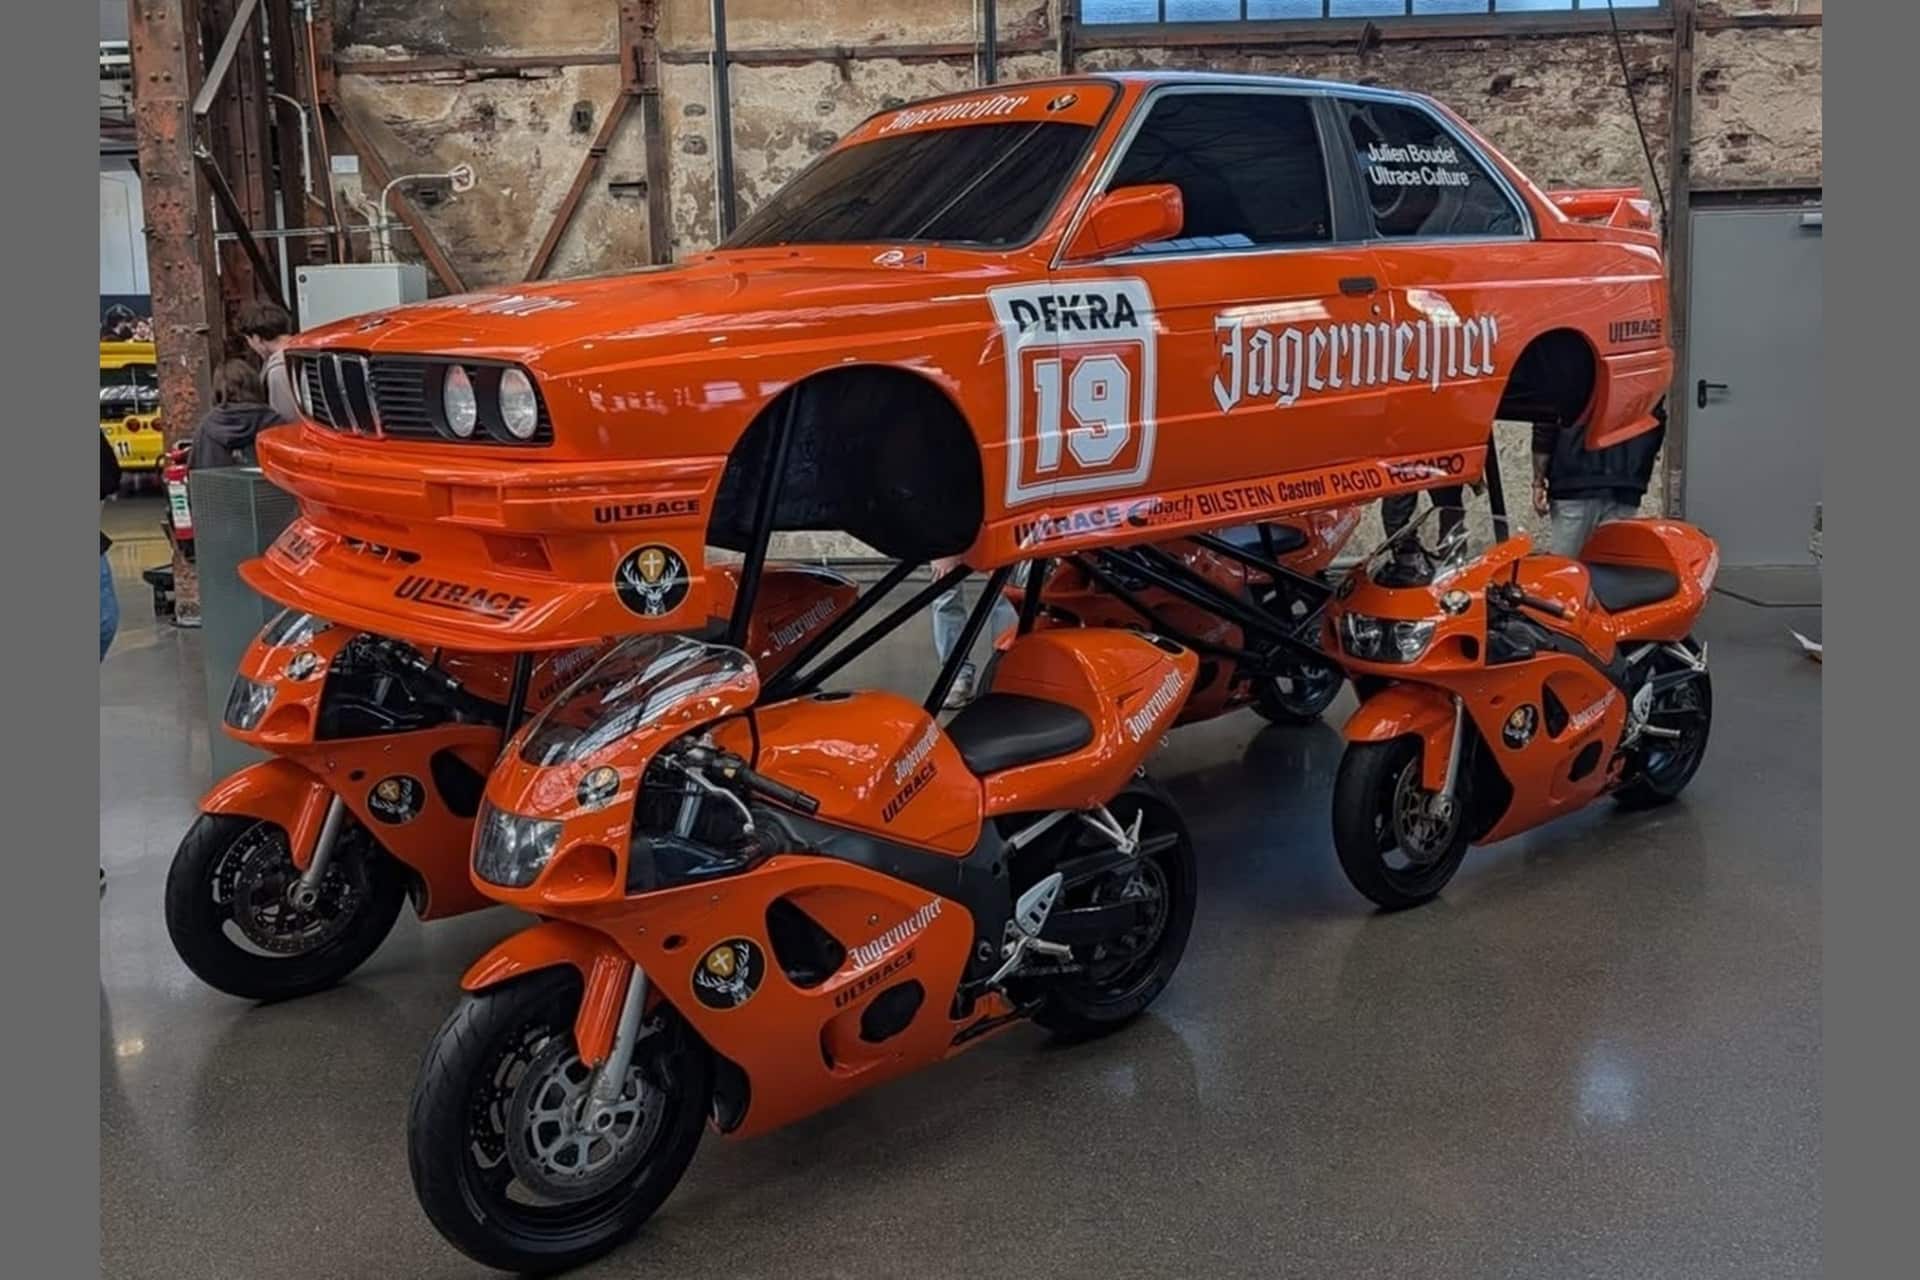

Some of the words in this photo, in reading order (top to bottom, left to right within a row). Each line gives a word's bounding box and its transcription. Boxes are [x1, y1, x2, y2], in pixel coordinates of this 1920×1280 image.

[1368, 143, 1410, 162] Julien
[1407, 144, 1459, 164] Boudet
[1369, 166, 1420, 185] Ultrace
[1420, 166, 1470, 187] Culture
[1008, 292, 1139, 334] DEKRA
[1608, 319, 1663, 344] ULTRACE
[1032, 353, 1132, 474] 19
[1197, 484, 1275, 516] BILSTEIN
[1278, 475, 1326, 501] Castrol
[1331, 467, 1383, 493] PAGID
[594, 499, 701, 524] ULTRACE
[394, 575, 532, 622] ULTRACE
